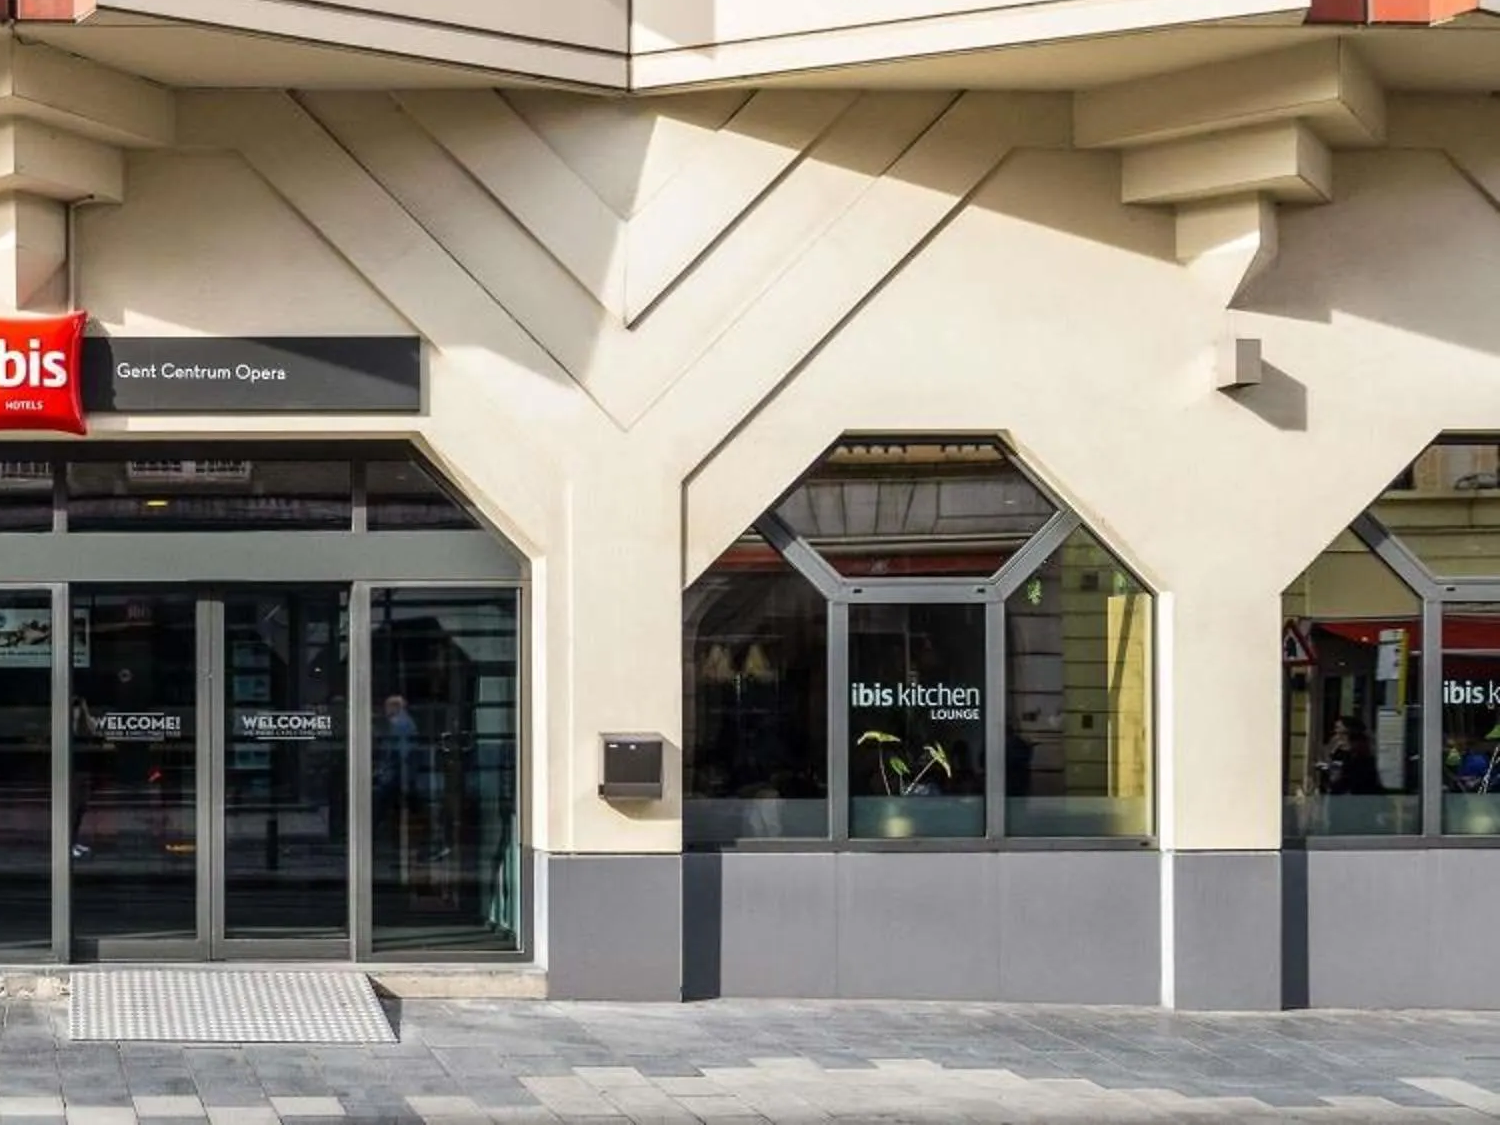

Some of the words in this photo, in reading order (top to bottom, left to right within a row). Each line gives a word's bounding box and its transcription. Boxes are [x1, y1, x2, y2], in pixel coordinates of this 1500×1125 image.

[116, 362, 157, 379] Gent
[161, 362, 231, 380] Centrum
[235, 363, 286, 384] Opera
[4, 400, 44, 411] HOTELS
[851, 682, 894, 707] ibis
[897, 682, 980, 707] kitchen
[1443, 679, 1485, 704] ibis
[930, 708, 980, 720] LOUNGE
[93, 715, 181, 730] WELCOME!
[241, 715, 332, 730] WELCOME!
